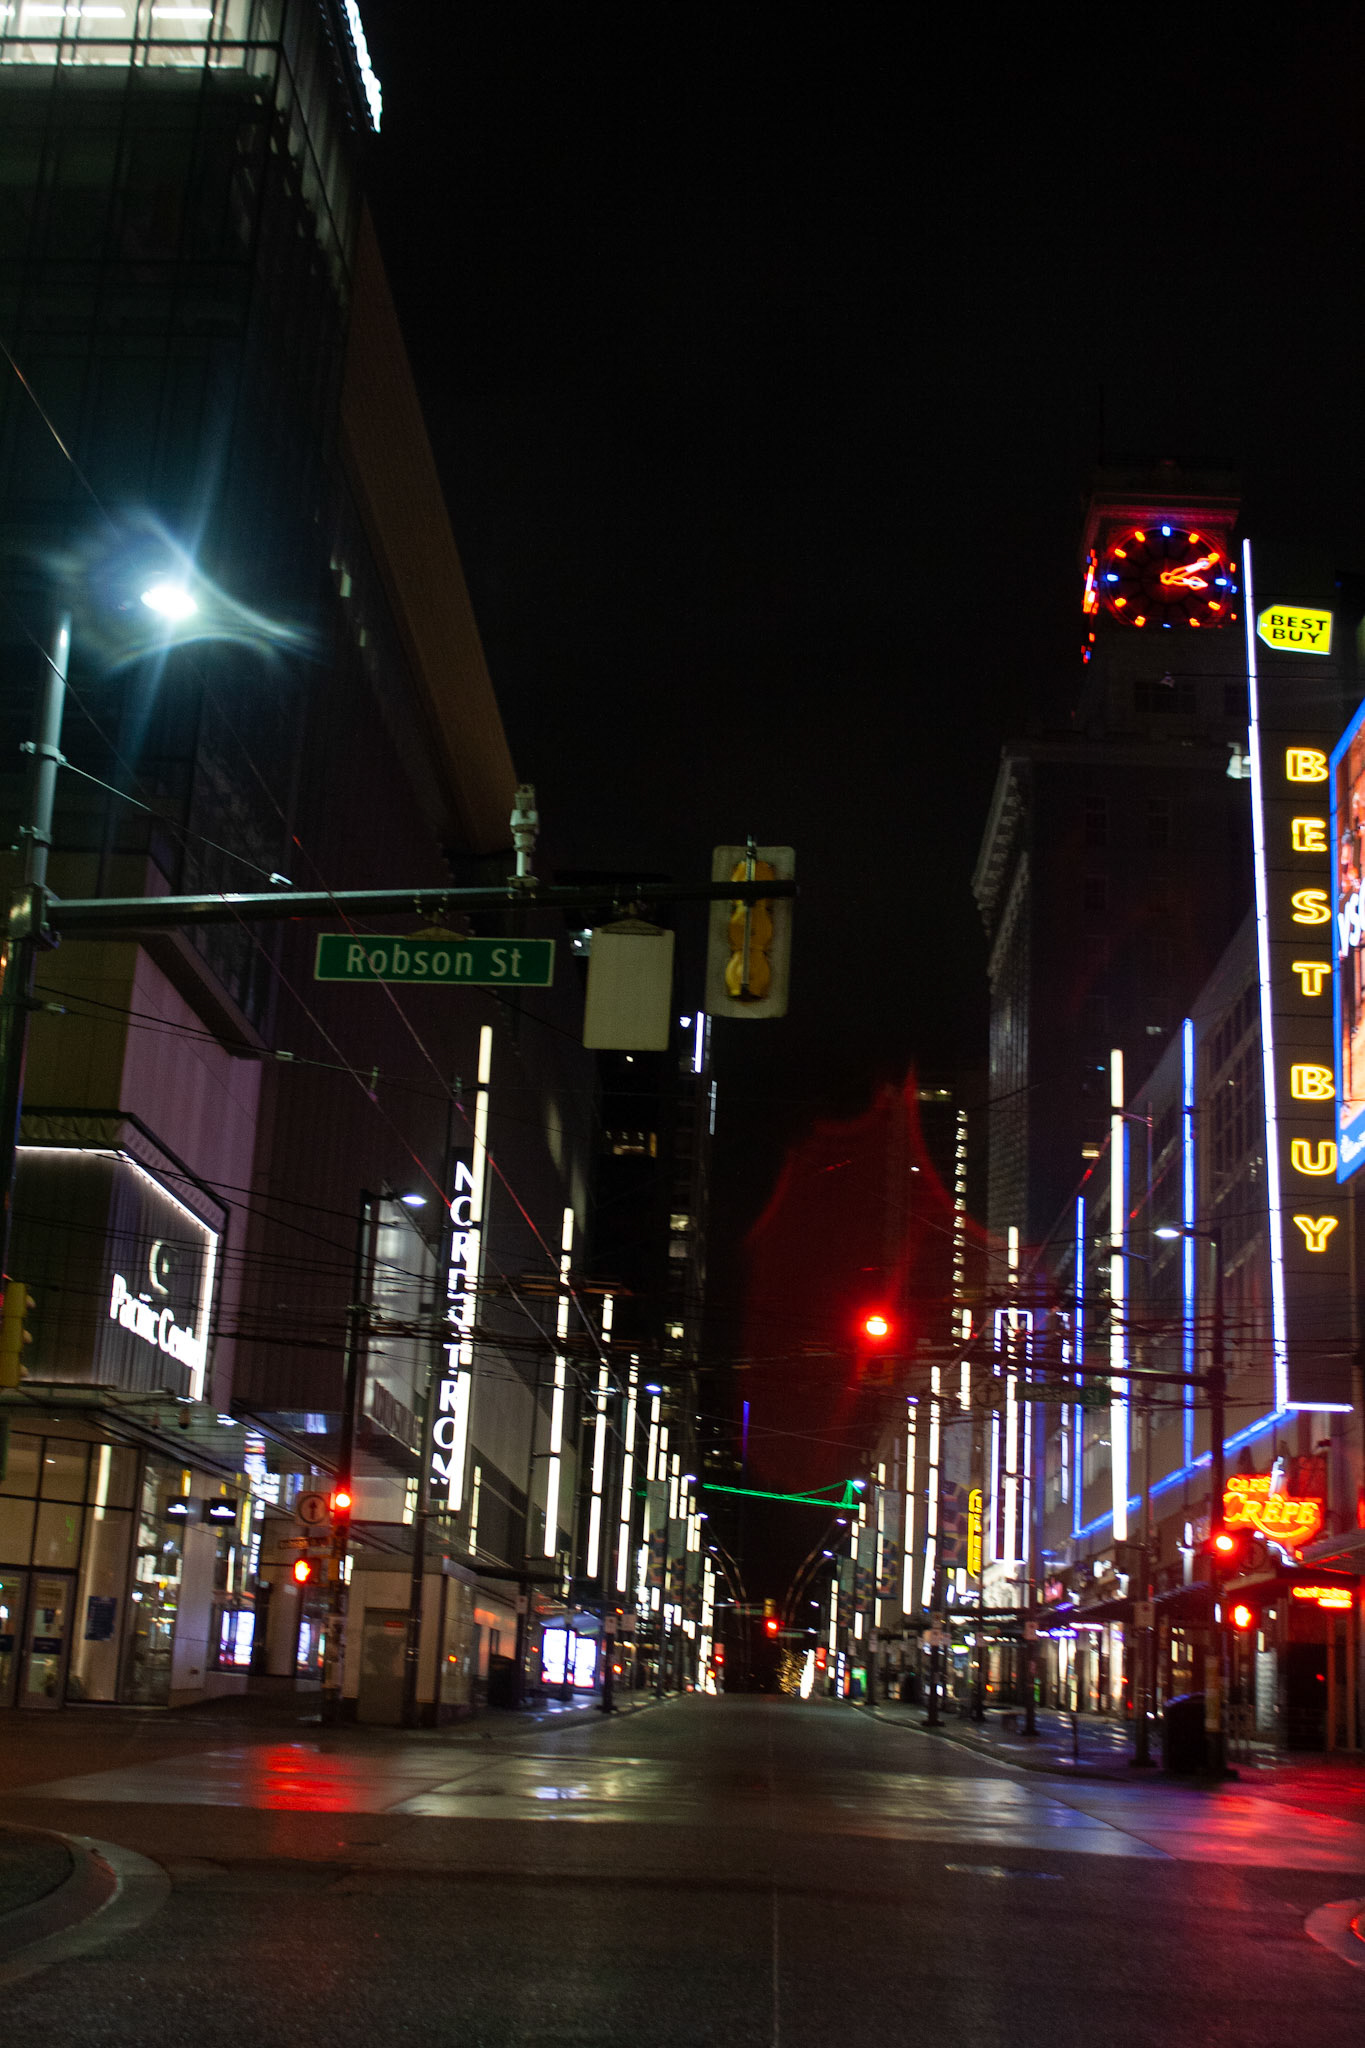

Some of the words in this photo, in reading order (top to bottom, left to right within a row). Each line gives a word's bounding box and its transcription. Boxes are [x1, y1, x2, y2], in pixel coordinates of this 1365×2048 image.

[1270, 614, 1328, 631] BEST
[1272, 628, 1321, 644] BUY
[1286, 747, 1333, 996] BEST
[346, 943, 474, 976] Robson
[490, 948, 522, 978] St
[1291, 1064, 1338, 1252] BUY
